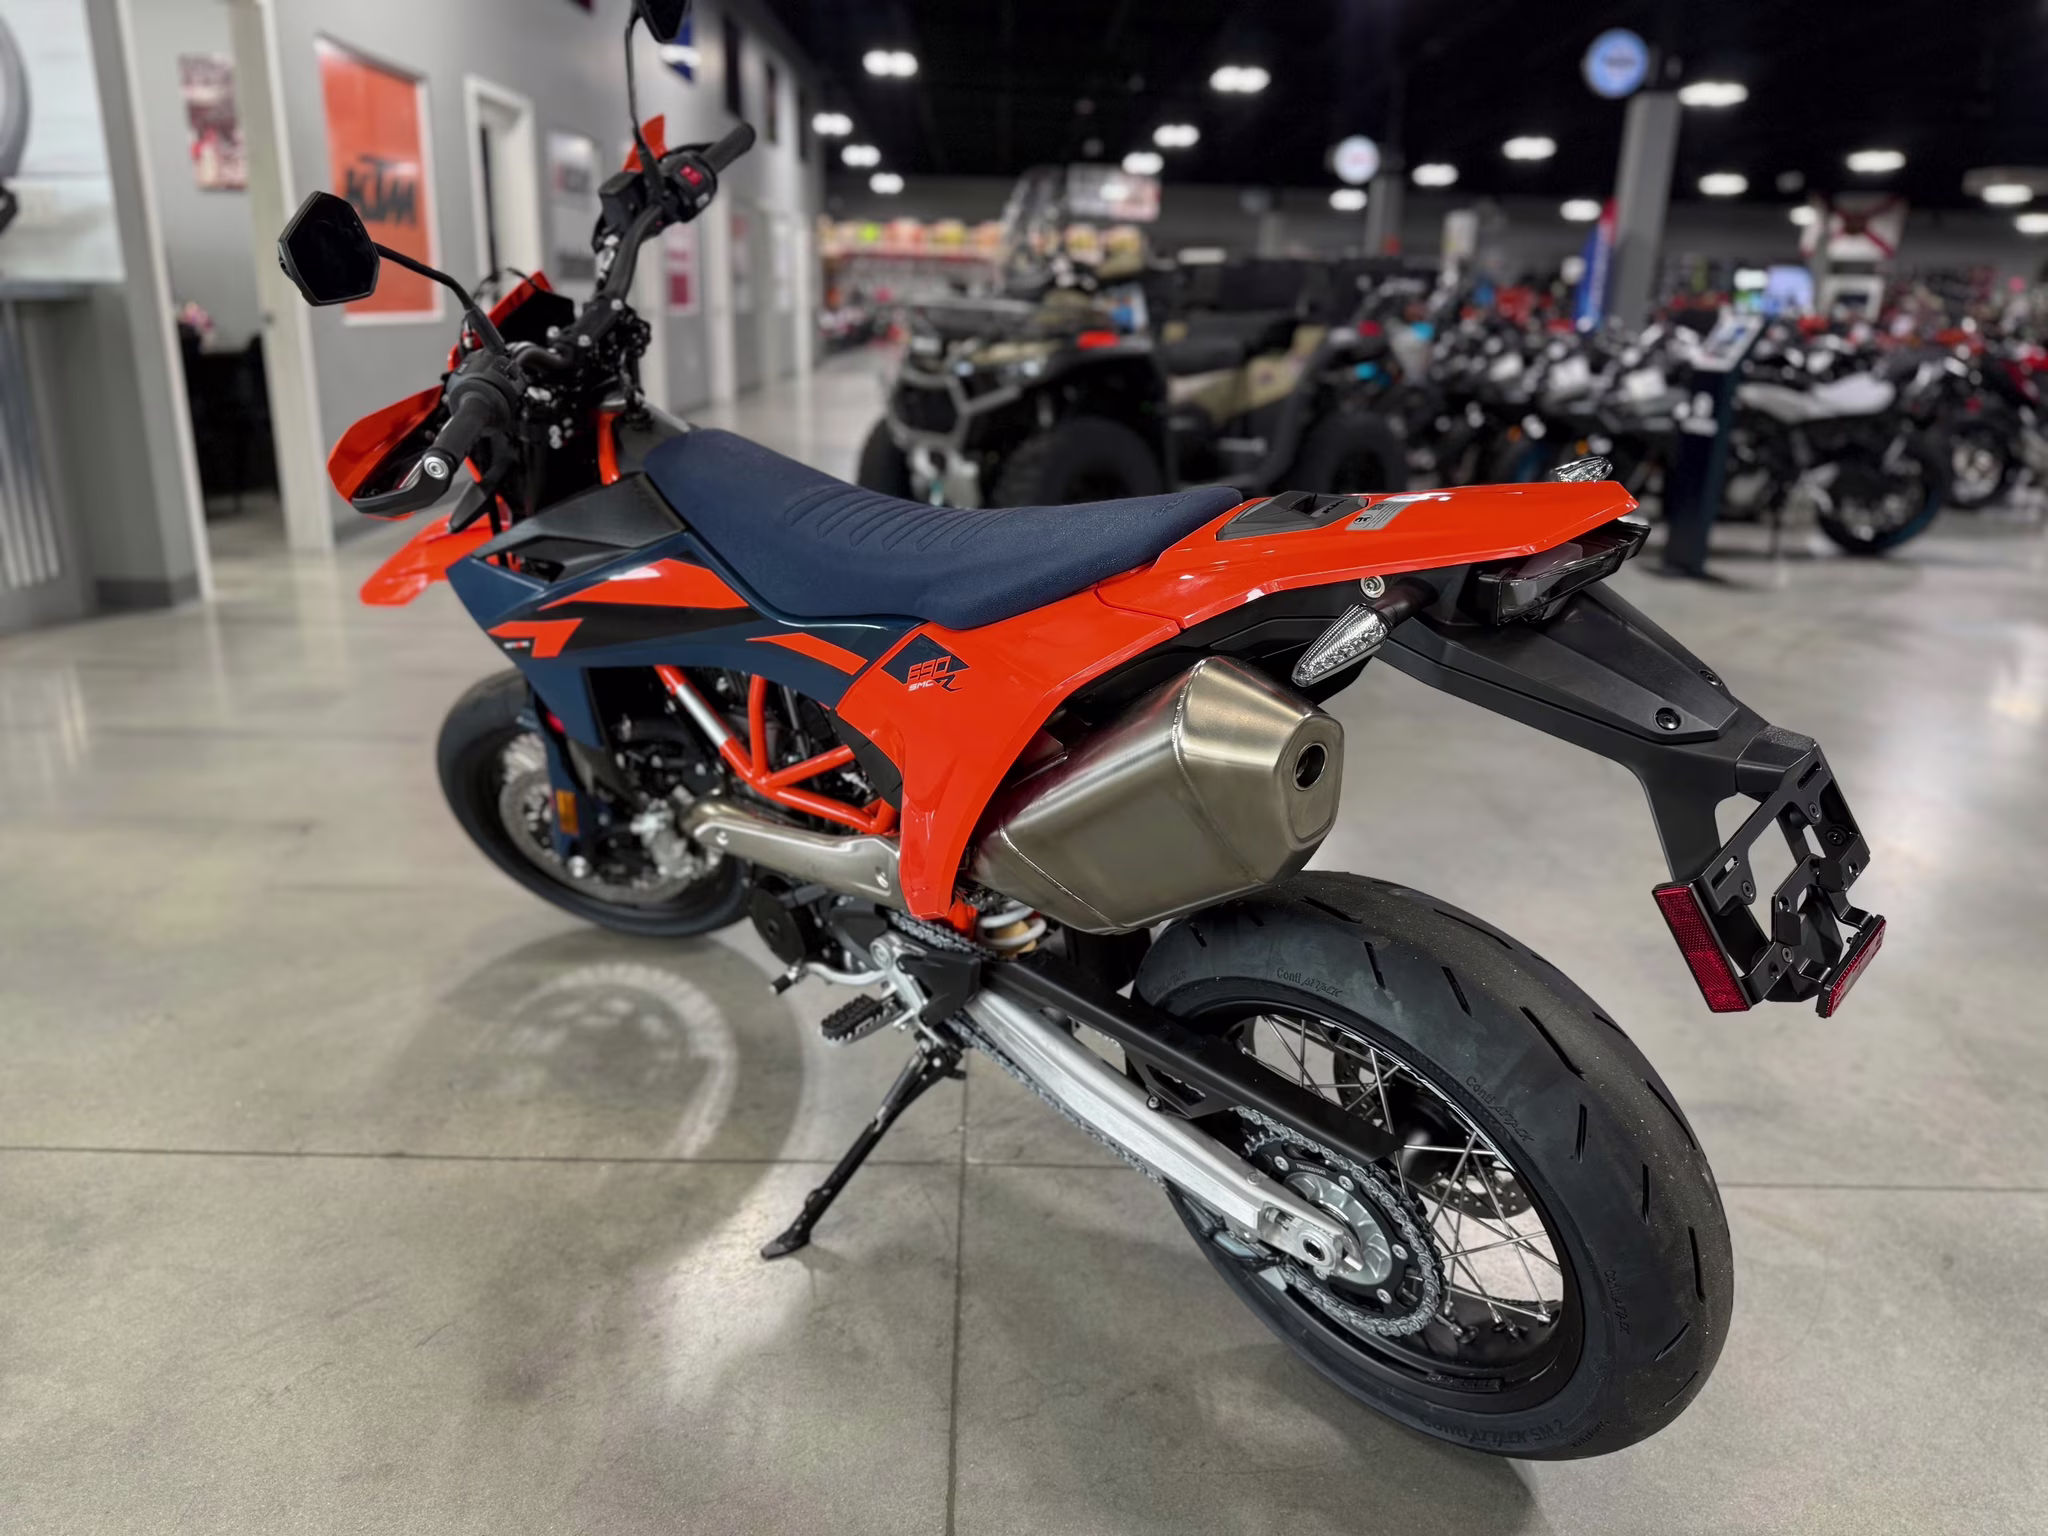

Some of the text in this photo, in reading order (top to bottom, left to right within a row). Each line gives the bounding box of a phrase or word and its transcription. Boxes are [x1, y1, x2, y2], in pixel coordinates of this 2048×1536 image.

[343, 152, 417, 228] KTM
[907, 655, 952, 682] 690
[908, 680, 935, 692] SMC
